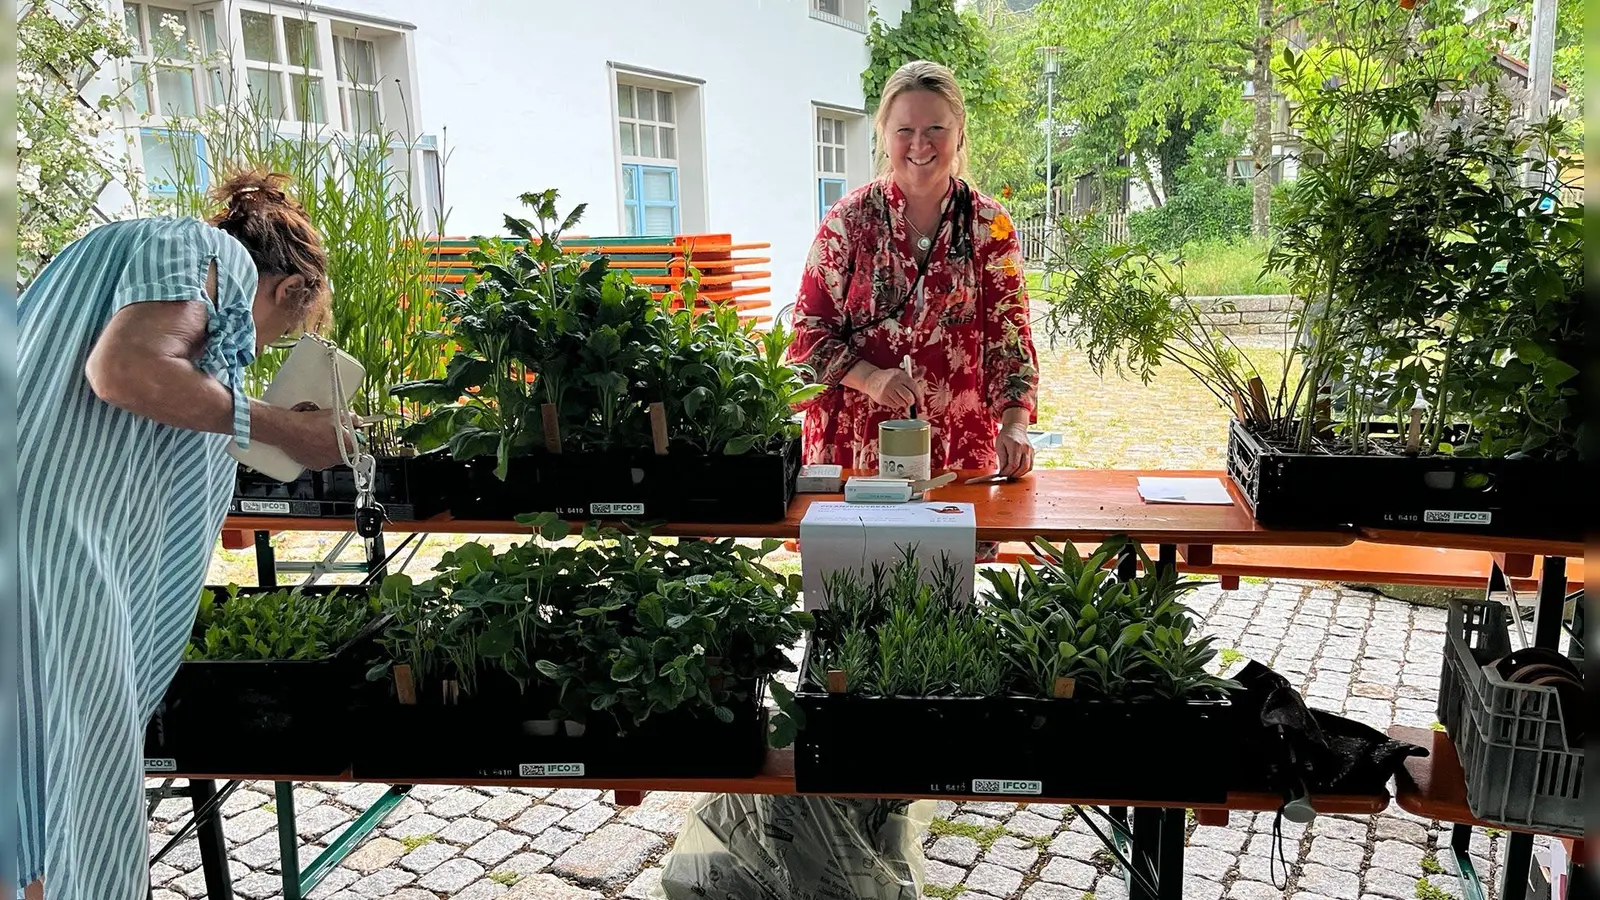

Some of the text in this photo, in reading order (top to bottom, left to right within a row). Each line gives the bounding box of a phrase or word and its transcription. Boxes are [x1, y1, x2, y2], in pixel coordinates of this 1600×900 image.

[1384, 512, 1477, 522] LL 6410 IFCO
[930, 783, 940, 791] LL
[1002, 781, 1028, 790] IFCO
